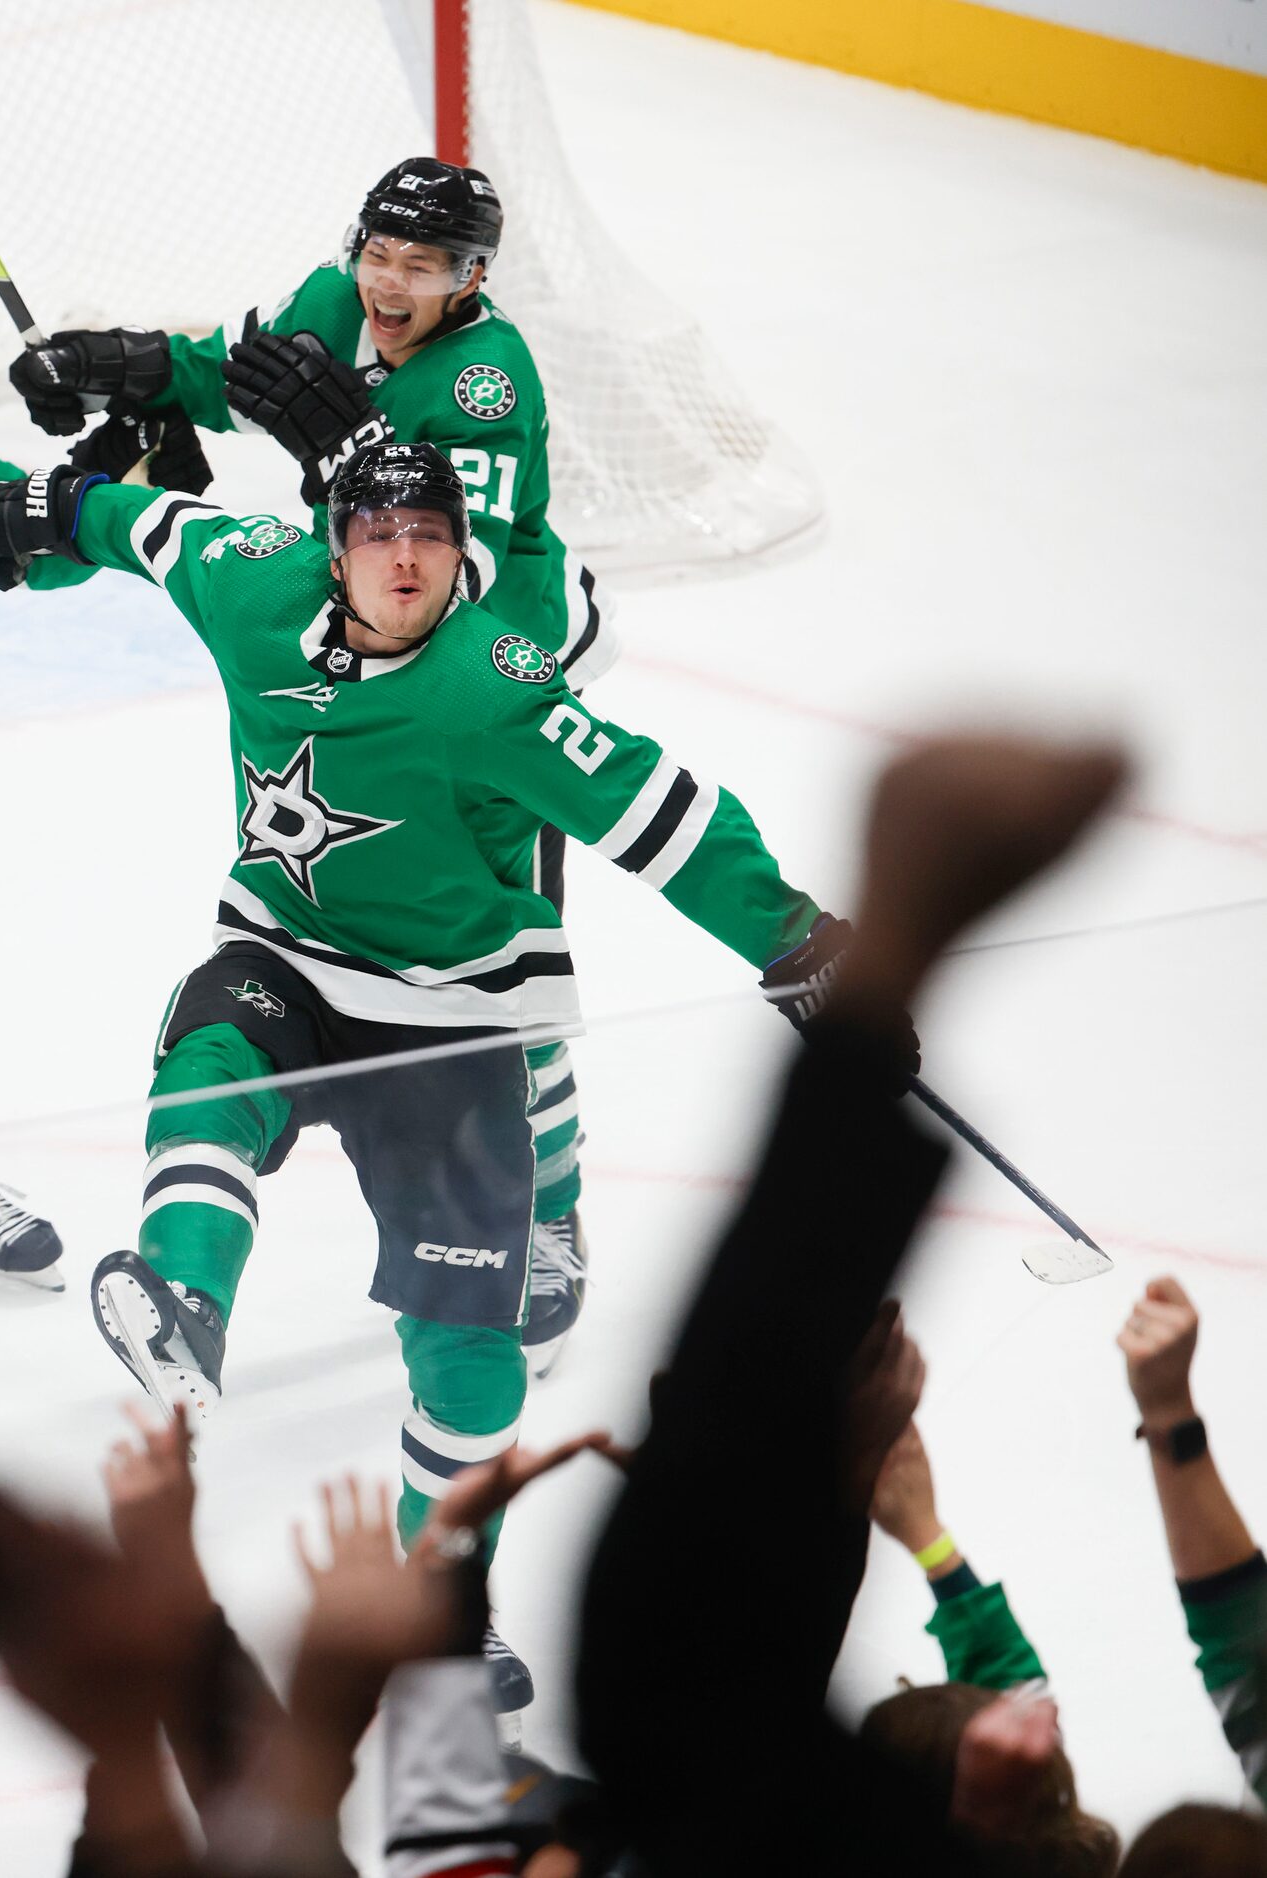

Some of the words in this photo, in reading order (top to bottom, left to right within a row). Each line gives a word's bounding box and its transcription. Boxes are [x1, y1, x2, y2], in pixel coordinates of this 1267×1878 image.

[397, 174, 424, 191] 21
[378, 202, 421, 218] CCM
[37, 351, 62, 384] CCM
[458, 368, 510, 391] DALLAS
[465, 396, 512, 417] STARS
[375, 471, 424, 481] CCM
[449, 447, 518, 526] 21
[496, 636, 538, 667] DALLAS
[516, 656, 553, 680] STARS
[538, 702, 617, 777] 2
[413, 1242, 509, 1269] CCM
